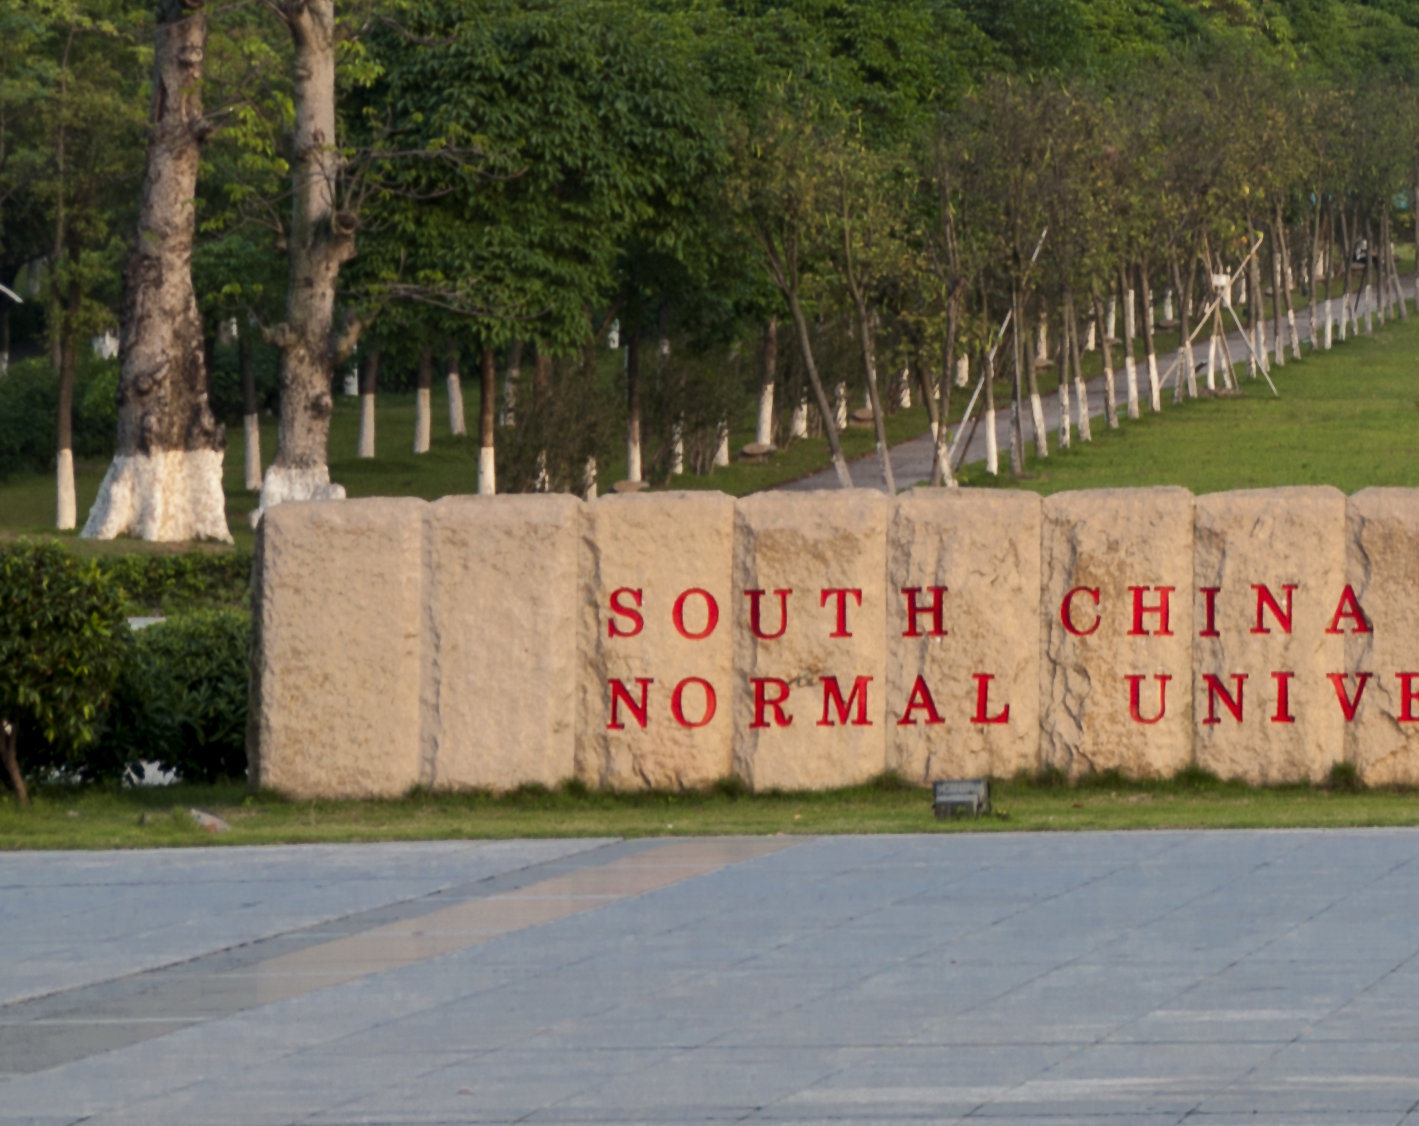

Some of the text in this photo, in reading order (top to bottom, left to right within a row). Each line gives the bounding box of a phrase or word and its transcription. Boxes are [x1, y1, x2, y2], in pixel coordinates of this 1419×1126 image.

[607, 583, 1374, 640] SOUTH CHINA
[606, 672, 1011, 731] NORMAL
